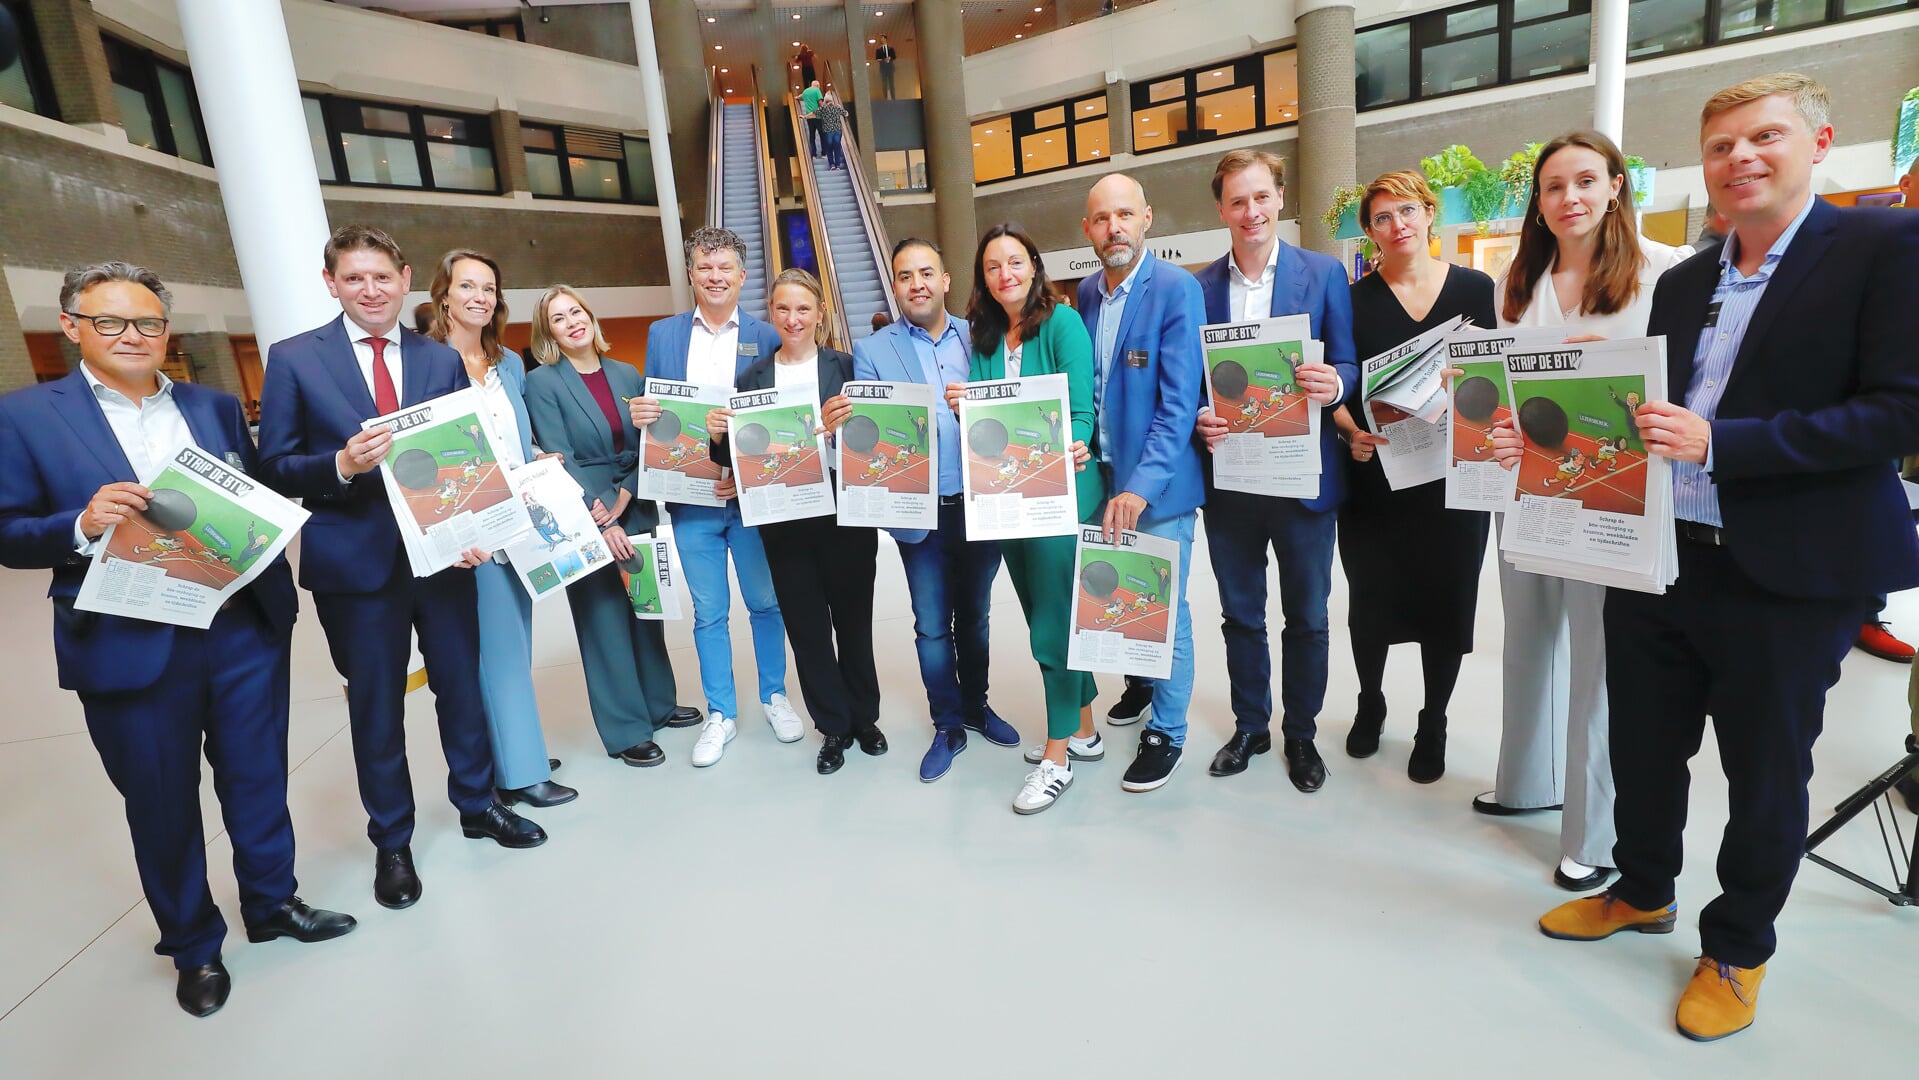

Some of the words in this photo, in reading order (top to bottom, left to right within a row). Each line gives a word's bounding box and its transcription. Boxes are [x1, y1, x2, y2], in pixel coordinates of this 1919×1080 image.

[1069, 259, 1103, 271] Comm
[1206, 329, 1228, 342] STRIP
[1229, 327, 1240, 340] DE
[1240, 325, 1259, 338] BTW
[1369, 358, 1390, 372] STRIP
[1390, 351, 1401, 361] DE
[1400, 341, 1418, 356] BTW
[1451, 344, 1475, 357] STRIP
[1477, 341, 1489, 354] DE
[1491, 339, 1514, 353] BTW
[1509, 355, 1537, 371] STRIP
[1538, 354, 1553, 370] DE
[1554, 351, 1581, 369] BTW
[650, 383, 671, 394] STRIP
[671, 385, 680, 396] DE
[680, 386, 697, 398] BTW
[847, 385, 864, 397] STRIP
[864, 386, 875, 397] DE
[875, 386, 892, 398] BTW
[966, 388, 989, 399] STRIP
[989, 386, 1000, 397] DE
[1001, 384, 1020, 398] BTW
[731, 396, 751, 409] STRIP
[752, 394, 762, 405] DE
[761, 392, 777, 404] BTW
[400, 414, 414, 428] DE
[411, 408, 431, 425] BTW
[179, 450, 213, 475] STRIP
[210, 468, 224, 484] DE
[223, 476, 251, 497] BTW
[1084, 530, 1104, 543] STRI
[1119, 534, 1136, 546] TW
[656, 543, 668, 564] STRIP
[659, 562, 668, 571] DE
